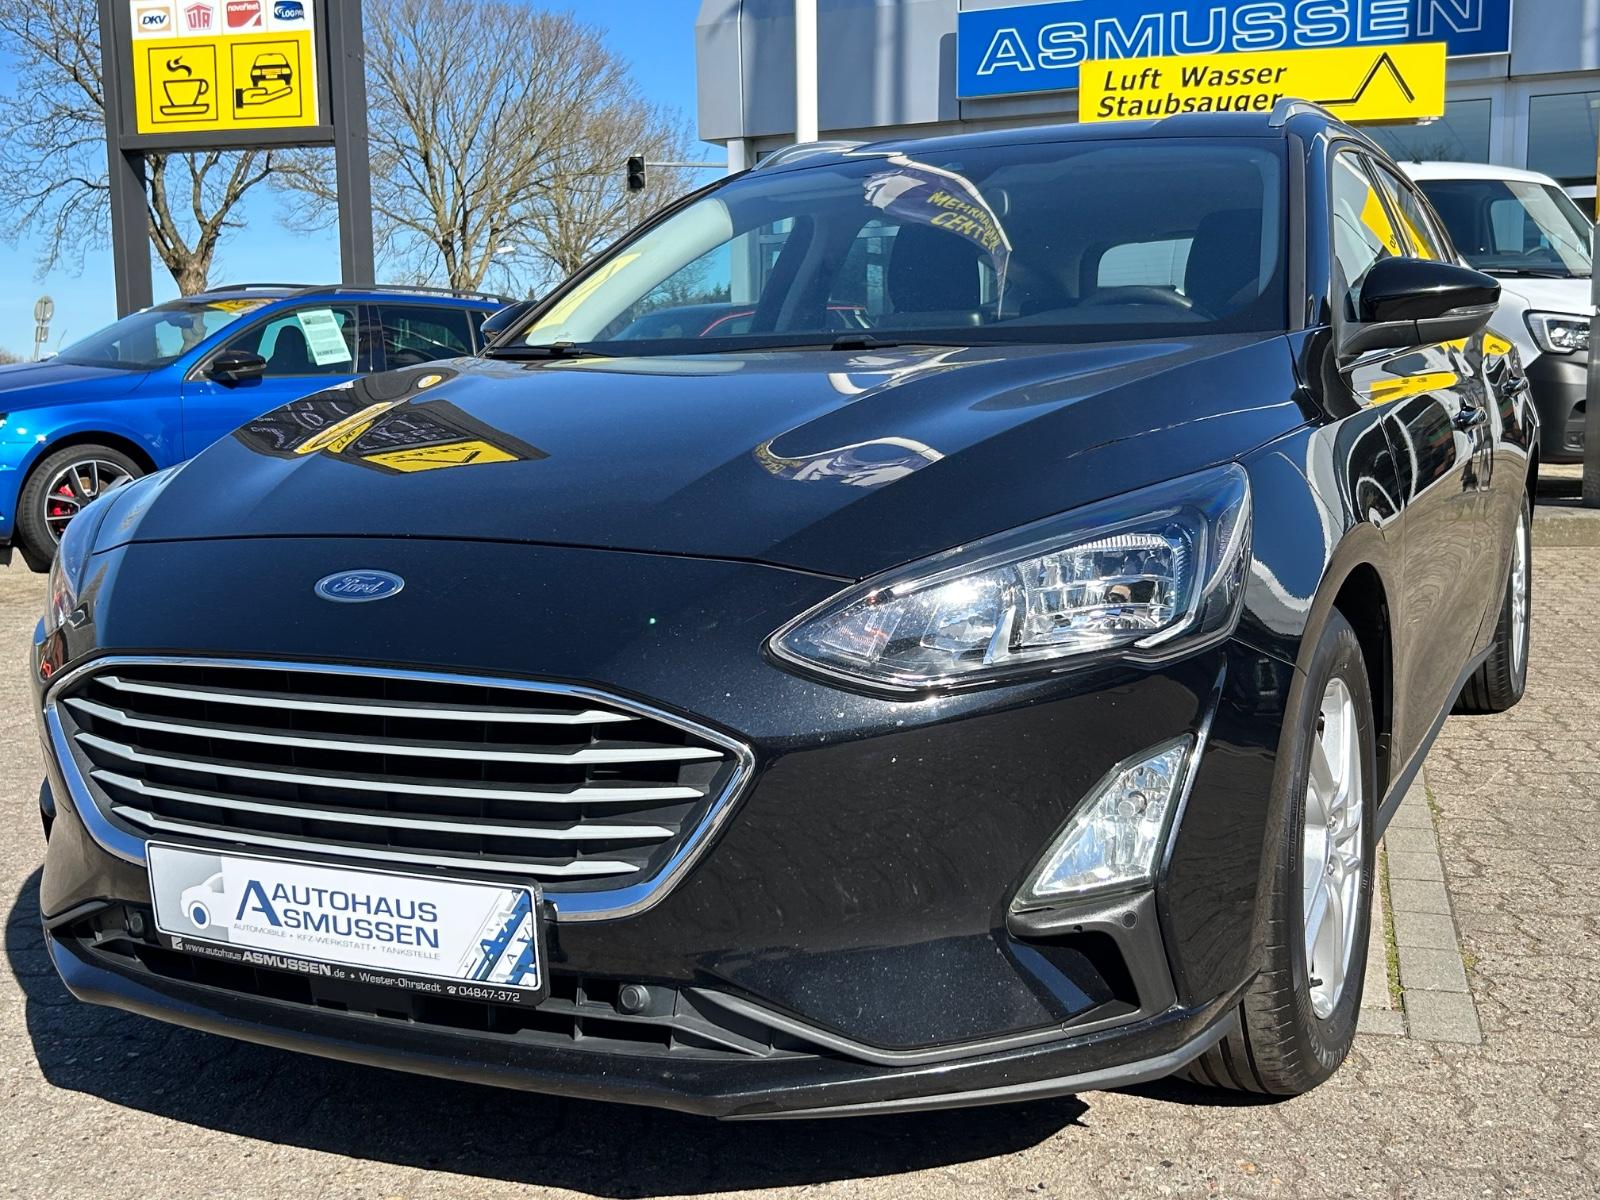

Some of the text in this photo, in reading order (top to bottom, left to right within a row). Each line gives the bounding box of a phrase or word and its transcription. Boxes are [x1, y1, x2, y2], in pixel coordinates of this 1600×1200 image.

[142, 15, 166, 25] DKV
[976, 0, 1485, 75] ASMUSSEN
[1103, 65, 1288, 92] Luft Wasser
[930, 211, 996, 255] CENTER
[332, 576, 385, 594] Ford
[271, 883, 439, 923] AUTOHAUS
[233, 923, 441, 961] AUTOMOBILE KFZ-WERKSTATT TANKSTELLE
[358, 972, 442, 993] Wester-Ohrstedt
[458, 986, 521, 1003] 04847-372
